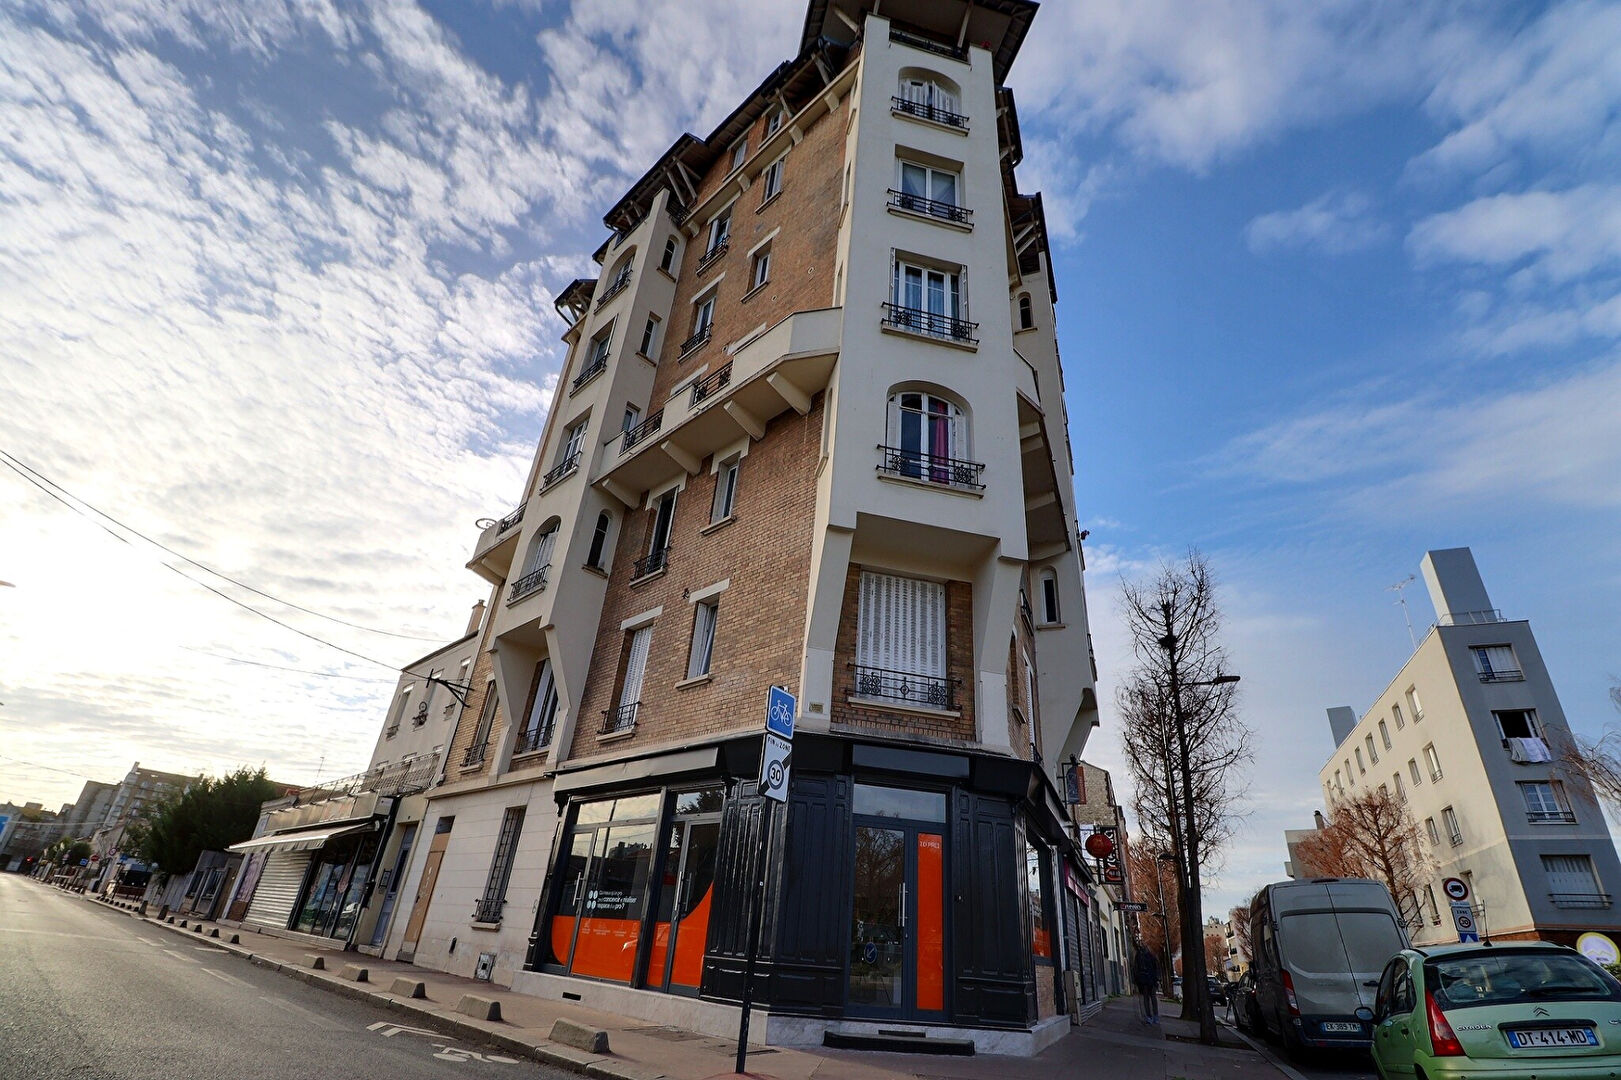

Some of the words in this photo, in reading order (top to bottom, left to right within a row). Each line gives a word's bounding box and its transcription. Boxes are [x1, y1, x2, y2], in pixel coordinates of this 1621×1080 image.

[767, 736, 776, 745] FIN
[779, 741, 791, 752] ZONE
[770, 766, 781, 781] 30
[1516, 1029, 1588, 1046] DT-414-MD
